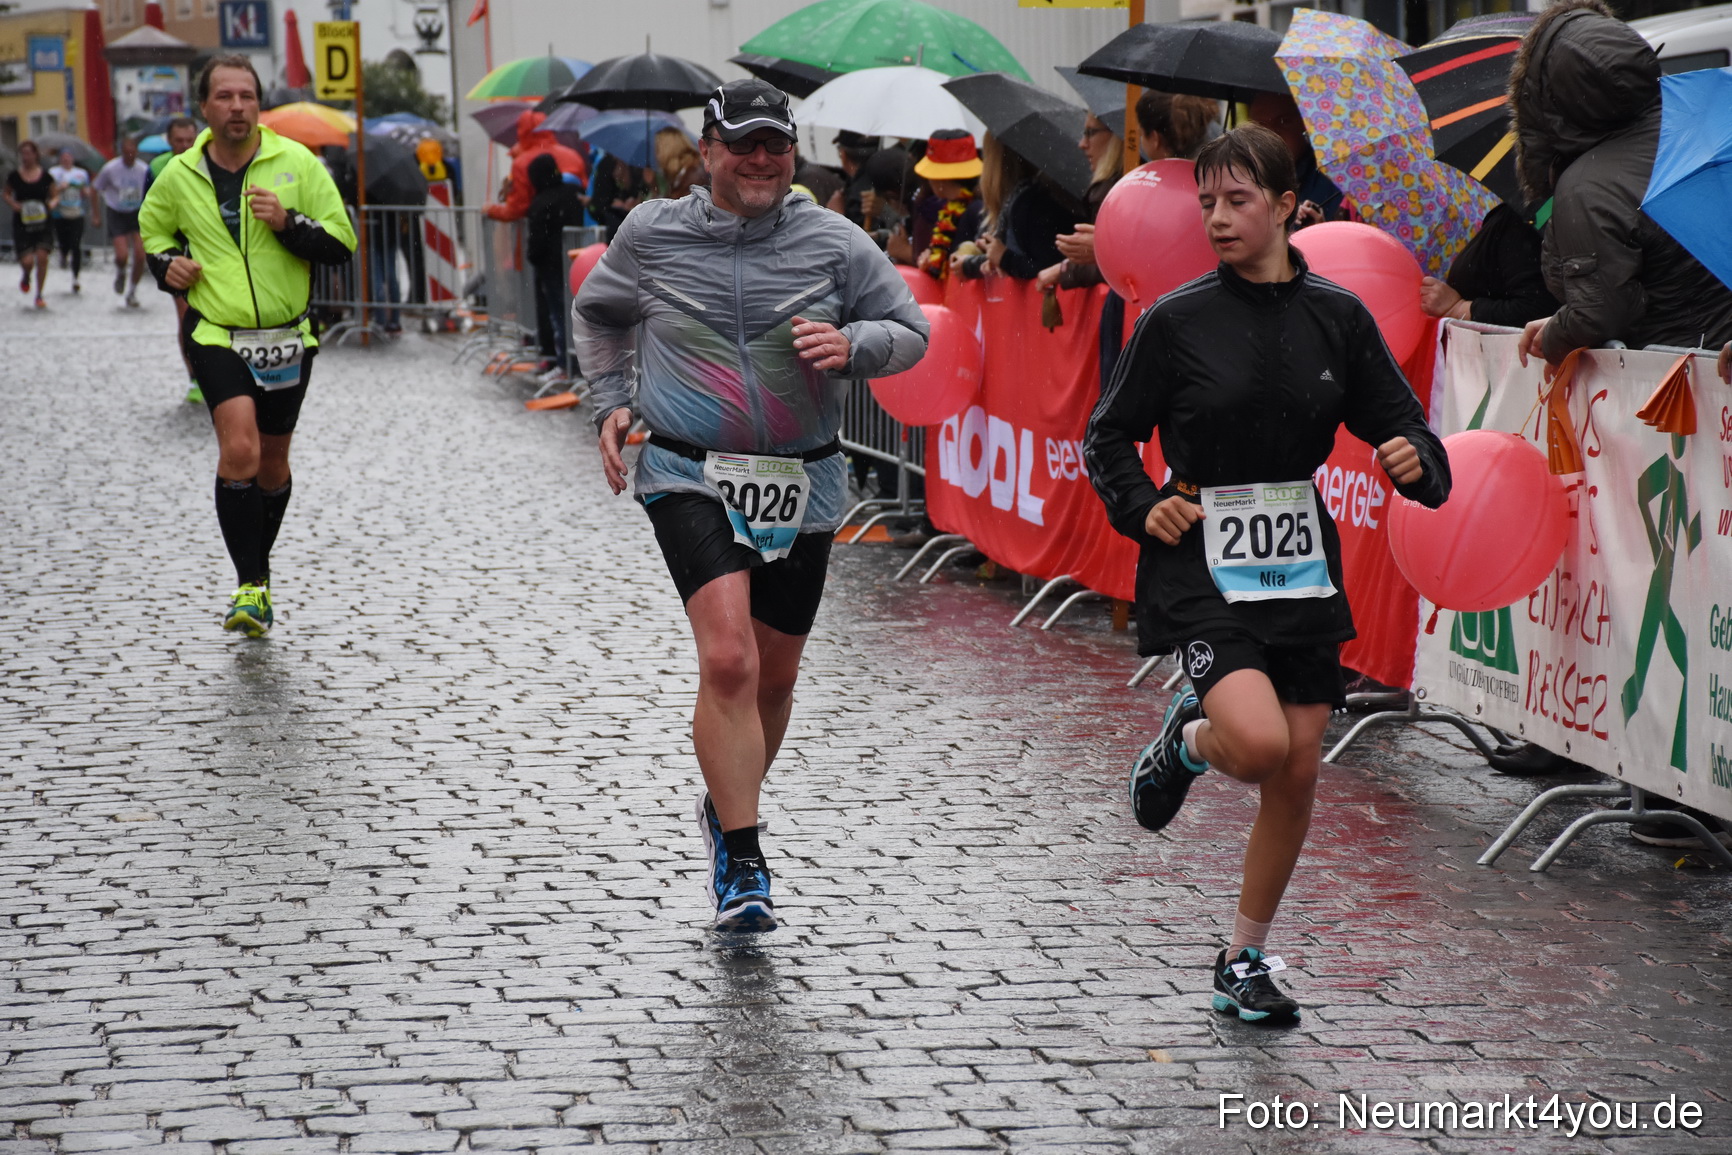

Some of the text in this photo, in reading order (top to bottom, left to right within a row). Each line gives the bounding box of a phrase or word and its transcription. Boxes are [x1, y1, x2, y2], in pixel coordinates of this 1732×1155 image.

[318, 24, 355, 38] Block
[326, 45, 349, 81] D
[714, 464, 750, 474] NeuerMarkt
[756, 460, 803, 475] BOCK
[717, 479, 801, 523] 2026
[1213, 498, 1256, 508] NeuerMarkt
[1220, 512, 1313, 560] 2025
[1260, 571, 1286, 587] Nia
[1191, 650, 1212, 674] FCN
